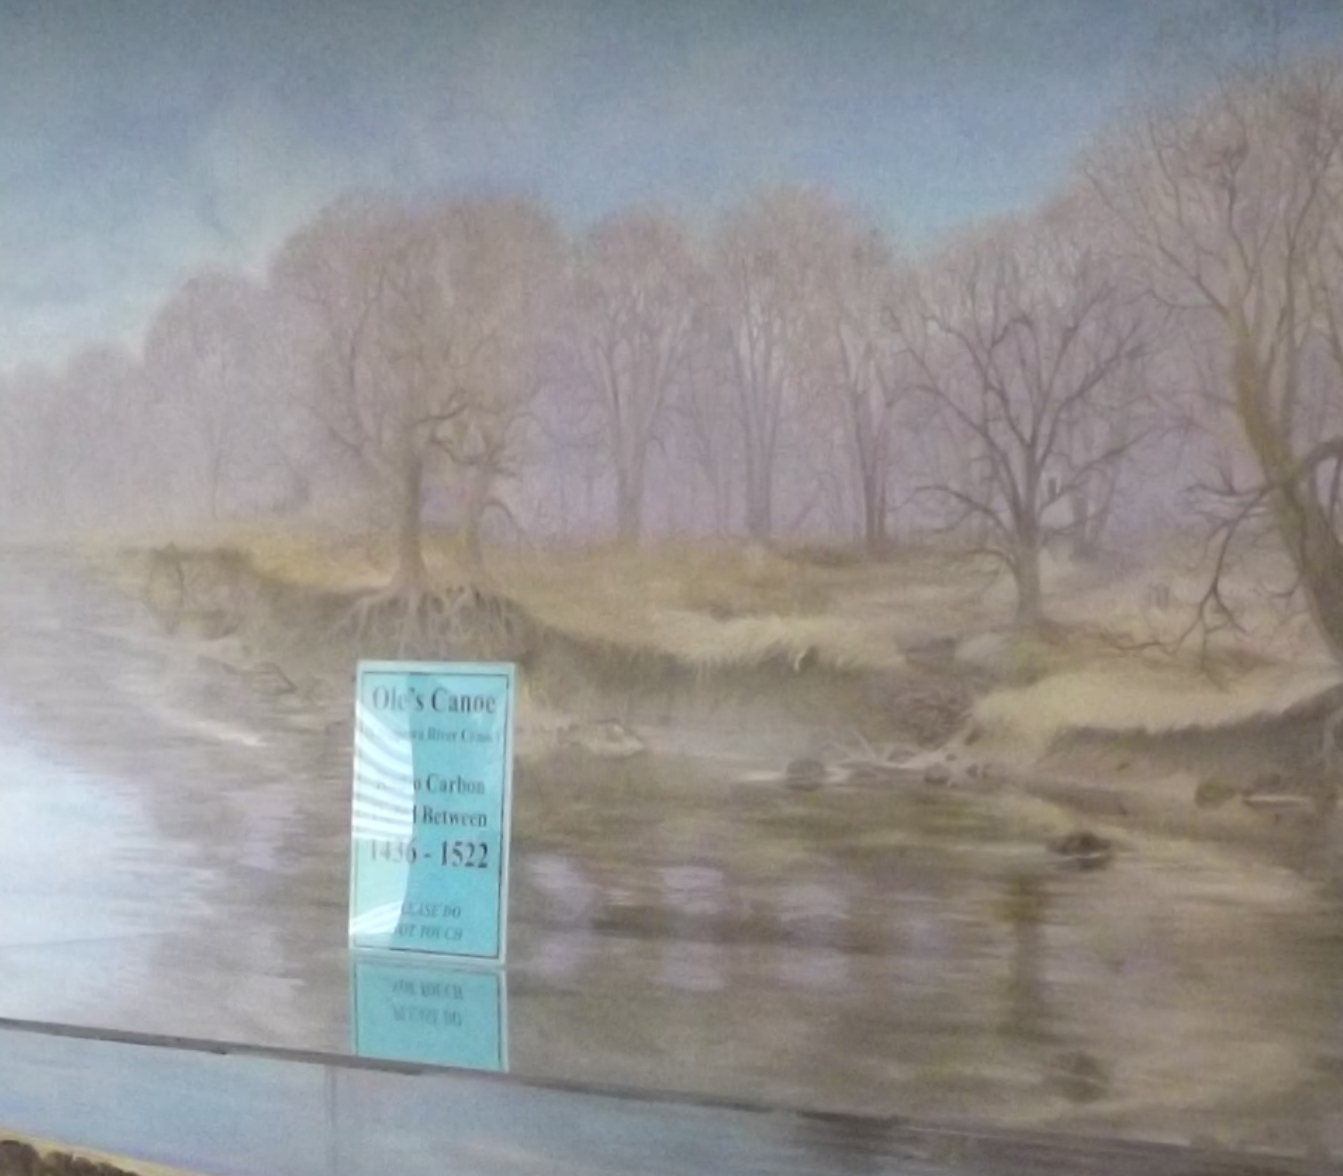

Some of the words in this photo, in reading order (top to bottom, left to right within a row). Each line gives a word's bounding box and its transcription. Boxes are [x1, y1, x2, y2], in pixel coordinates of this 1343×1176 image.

[372, 686, 425, 713] Ole's
[431, 686, 496, 714] Canoe
[426, 773, 486, 795] Carbon
[423, 806, 488, 828] Between
[440, 840, 488, 869] 1522
[442, 904, 462, 919] DO
[419, 925, 463, 941] TOUCH
